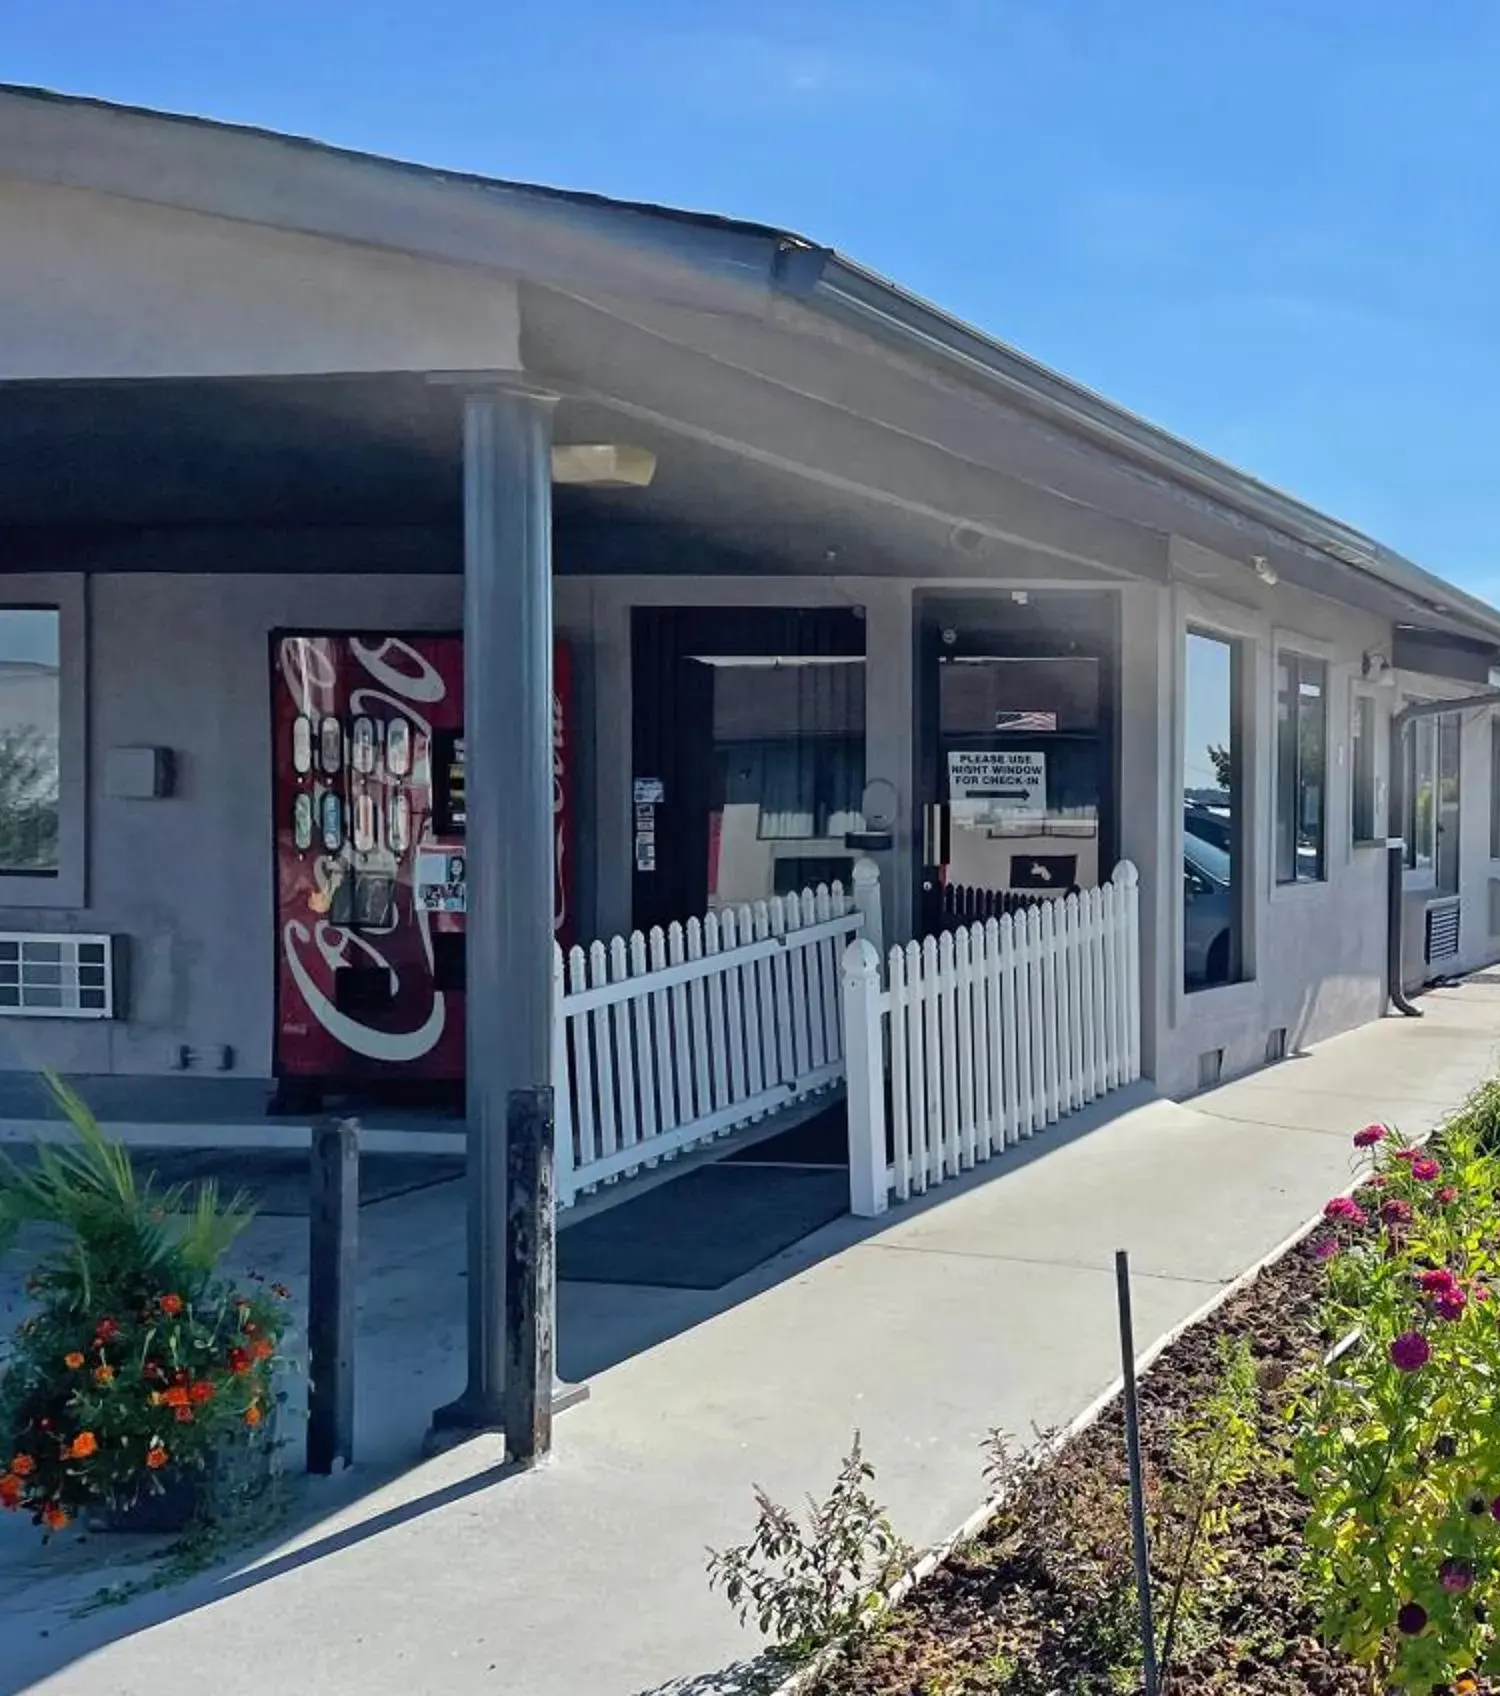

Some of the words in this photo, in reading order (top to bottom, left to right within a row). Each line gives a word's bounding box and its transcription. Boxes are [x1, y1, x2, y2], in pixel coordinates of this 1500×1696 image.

[960, 754, 1004, 764] PLEASE
[1009, 754, 1032, 764] USE
[951, 765, 988, 775] NIGHT
[991, 765, 1042, 775] WINDOW
[955, 775, 979, 785] FOR
[981, 775, 1040, 785] CHECK-IN
